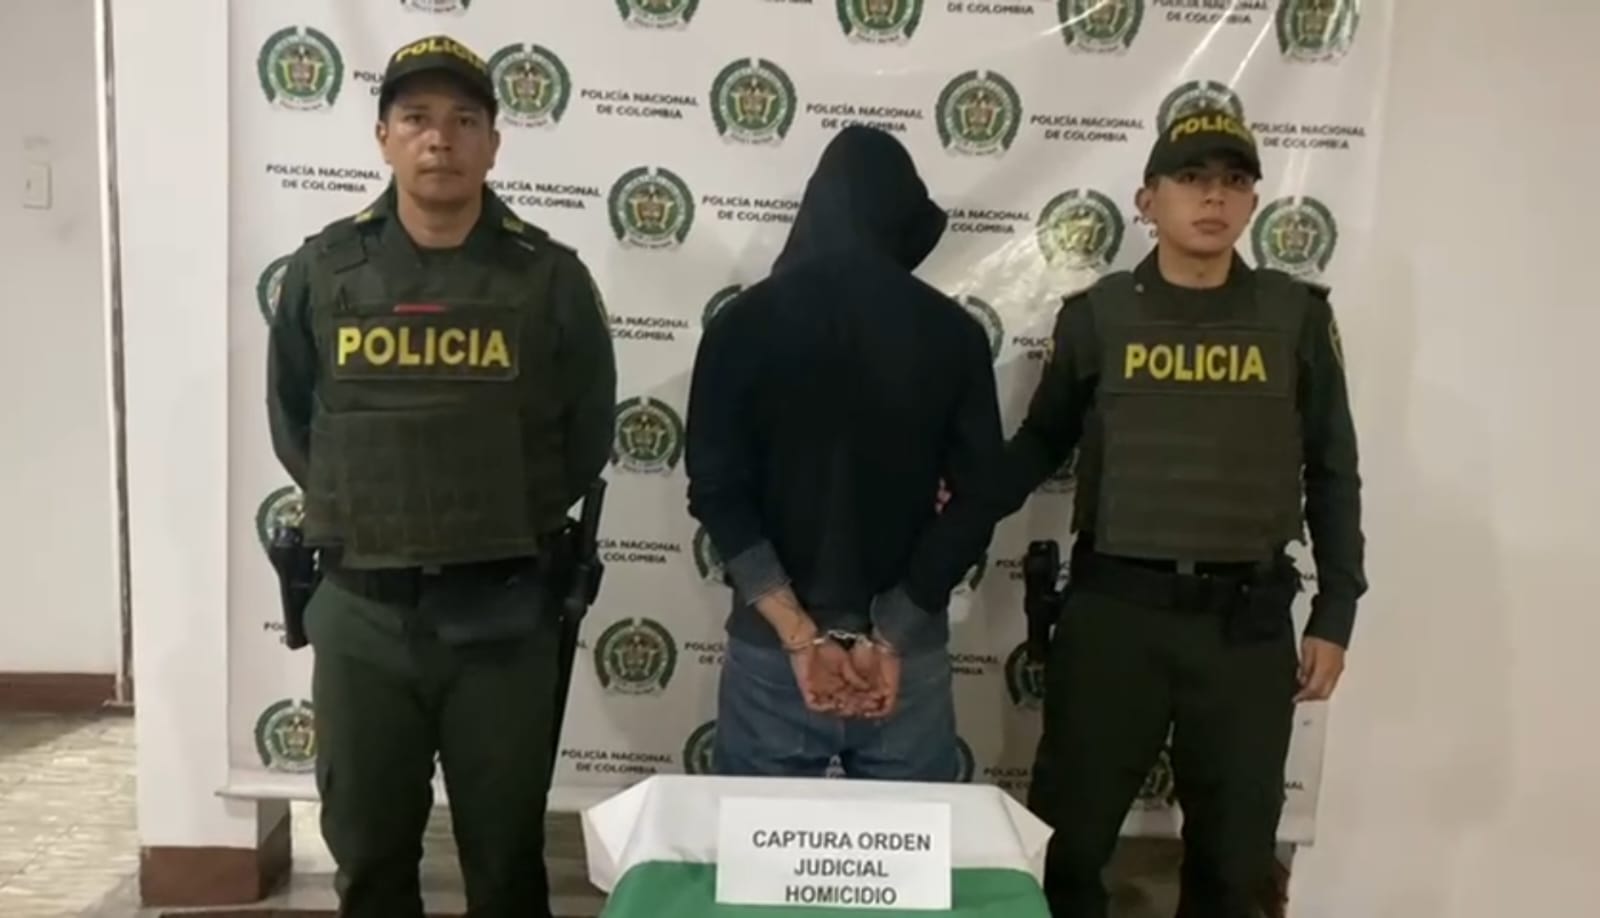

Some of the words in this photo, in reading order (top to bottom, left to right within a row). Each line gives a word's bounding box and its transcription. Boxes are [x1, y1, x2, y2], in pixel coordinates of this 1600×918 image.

[946, 2, 962, 13] DE
[967, 3, 1034, 15] COLOMBIA
[1184, 11, 1251, 24] COLOBIA
[633, 92, 699, 107] NACIONAL
[597, 104, 612, 115] DE
[616, 105, 683, 119] COLOMBIA
[806, 102, 855, 115] POLICÍA
[858, 106, 924, 120] NACIONAL
[821, 118, 837, 129] DE
[1081, 116, 1144, 130] NACIONAL
[1045, 129, 1060, 139] DE
[1063, 129, 1128, 143] COLOMBIA
[1300, 124, 1365, 137] NACIONAL
[1263, 137, 1279, 147] DE
[1282, 137, 1349, 150] COLOMBIA
[318, 167, 382, 181] NACIONAL
[282, 179, 298, 189] DE
[301, 179, 367, 192] COLOMBIA
[535, 182, 601, 197] NACIONAL
[518, 195, 585, 209] COLOMBIA
[754, 198, 801, 210] NACION
[717, 209, 734, 220] DE
[968, 208, 1031, 221] NACIONAL
[951, 222, 1015, 234] COLOMBIA
[626, 316, 689, 328] NACIONAL
[337, 325, 511, 368] POLICIA
[1124, 343, 1268, 382] POLICIA
[620, 540, 682, 553] NACIONAL
[603, 551, 667, 564] COLOMBIA
[611, 751, 674, 764] NACIONAL
[576, 761, 591, 772] DE
[594, 762, 658, 775] COLOMBIA
[752, 830, 853, 849] CAPTURA
[857, 832, 931, 851] ORDEN
[794, 859, 889, 877] JUDICIAL
[785, 885, 897, 905] HOMICIDIO
